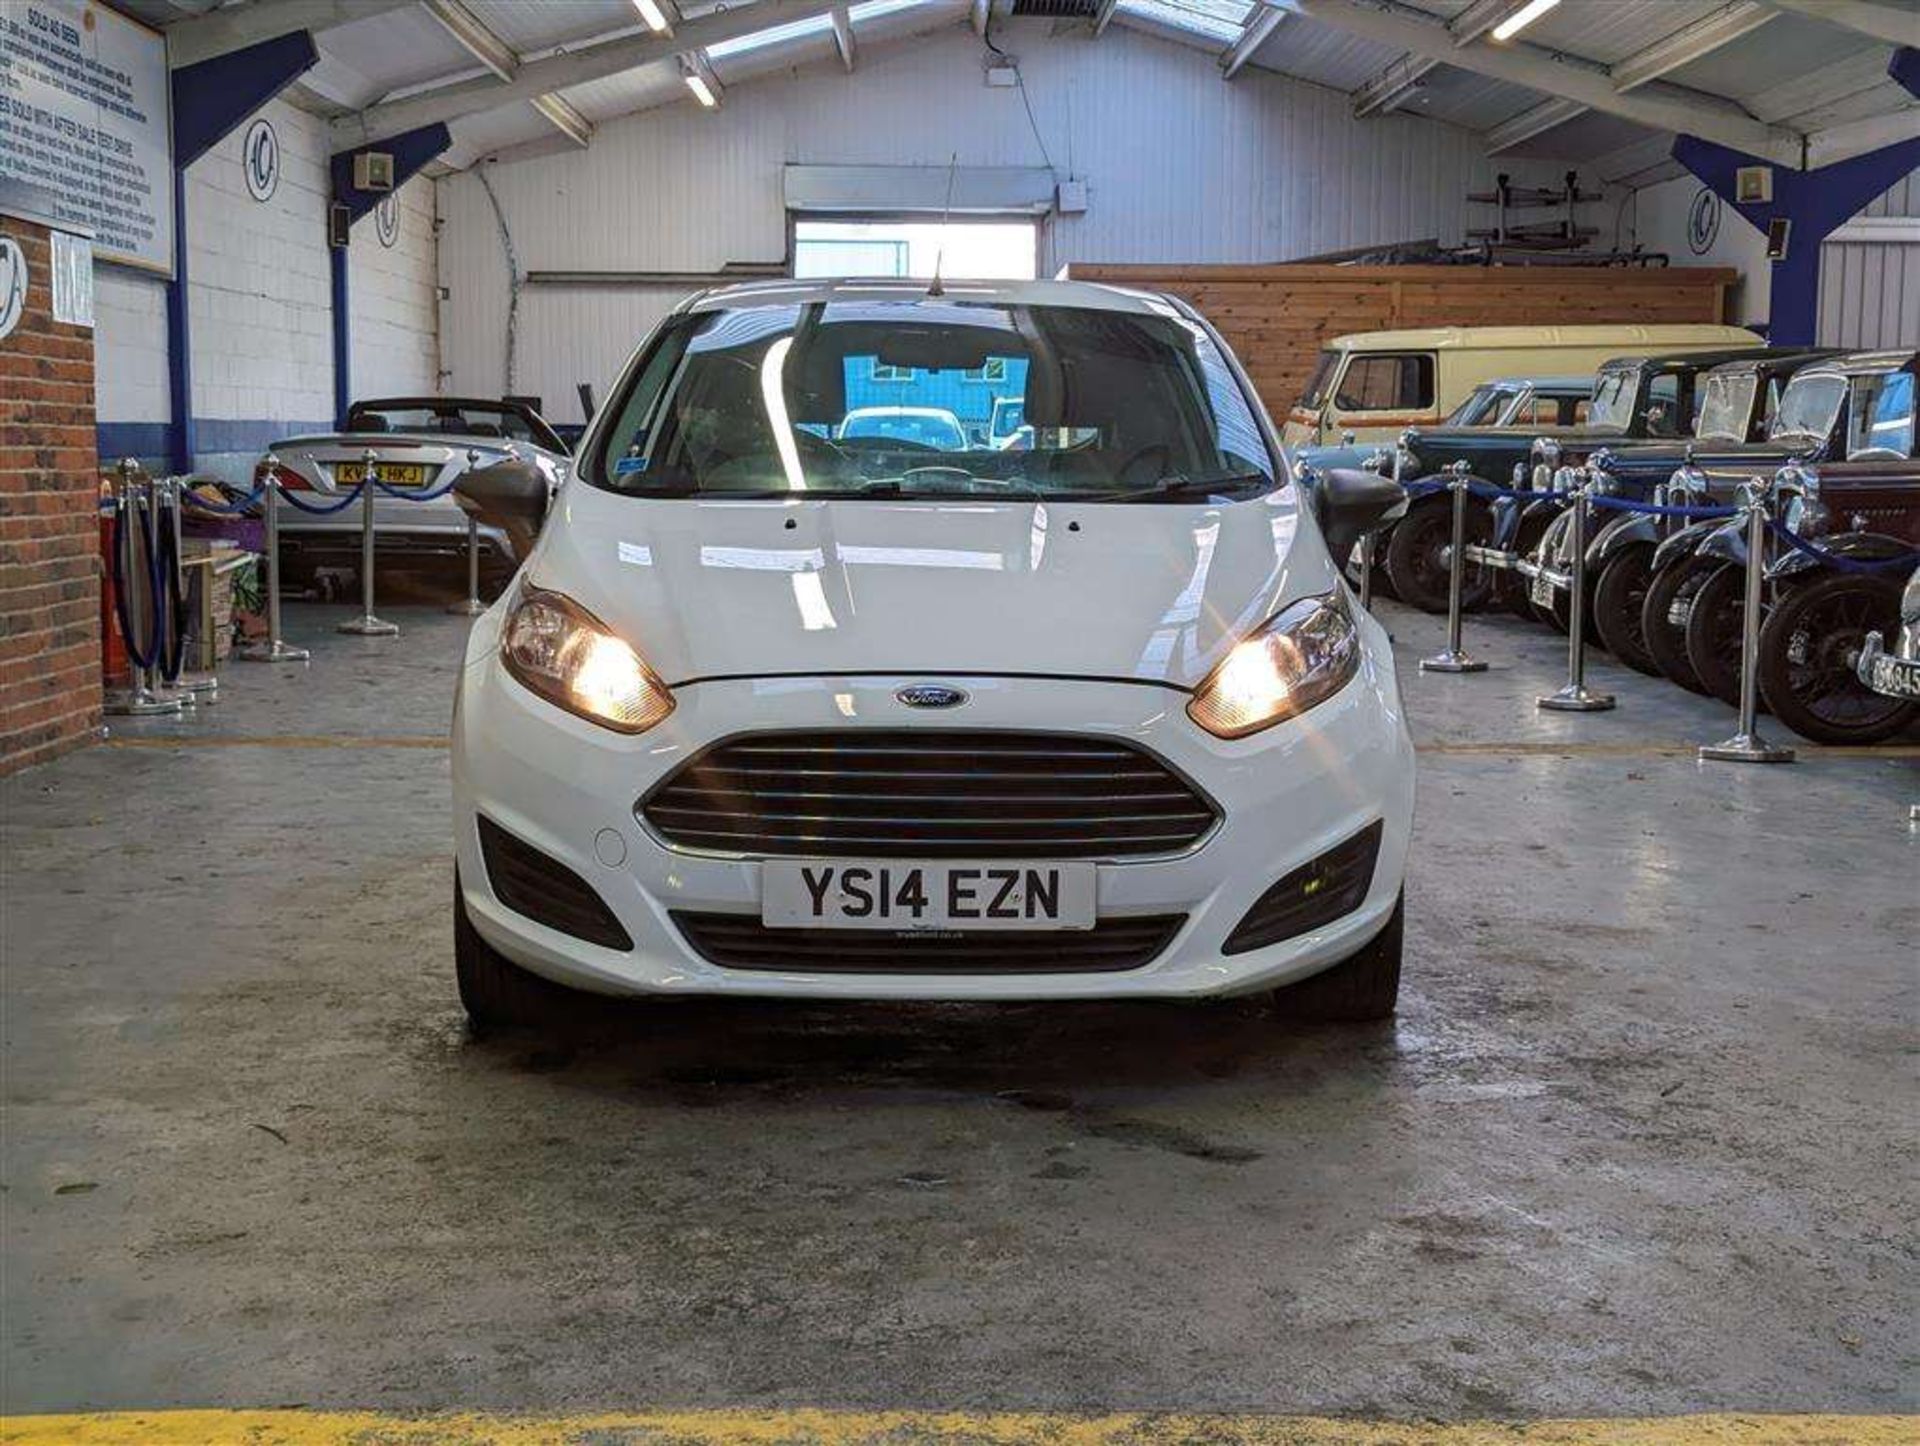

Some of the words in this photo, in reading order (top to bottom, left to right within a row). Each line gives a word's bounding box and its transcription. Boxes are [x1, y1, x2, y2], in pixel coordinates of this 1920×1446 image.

[28, 8, 48, 32] SOLD
[387, 466, 417, 481] HKJ
[801, 867, 929, 917] YS14
[947, 868, 1059, 918] EZN
